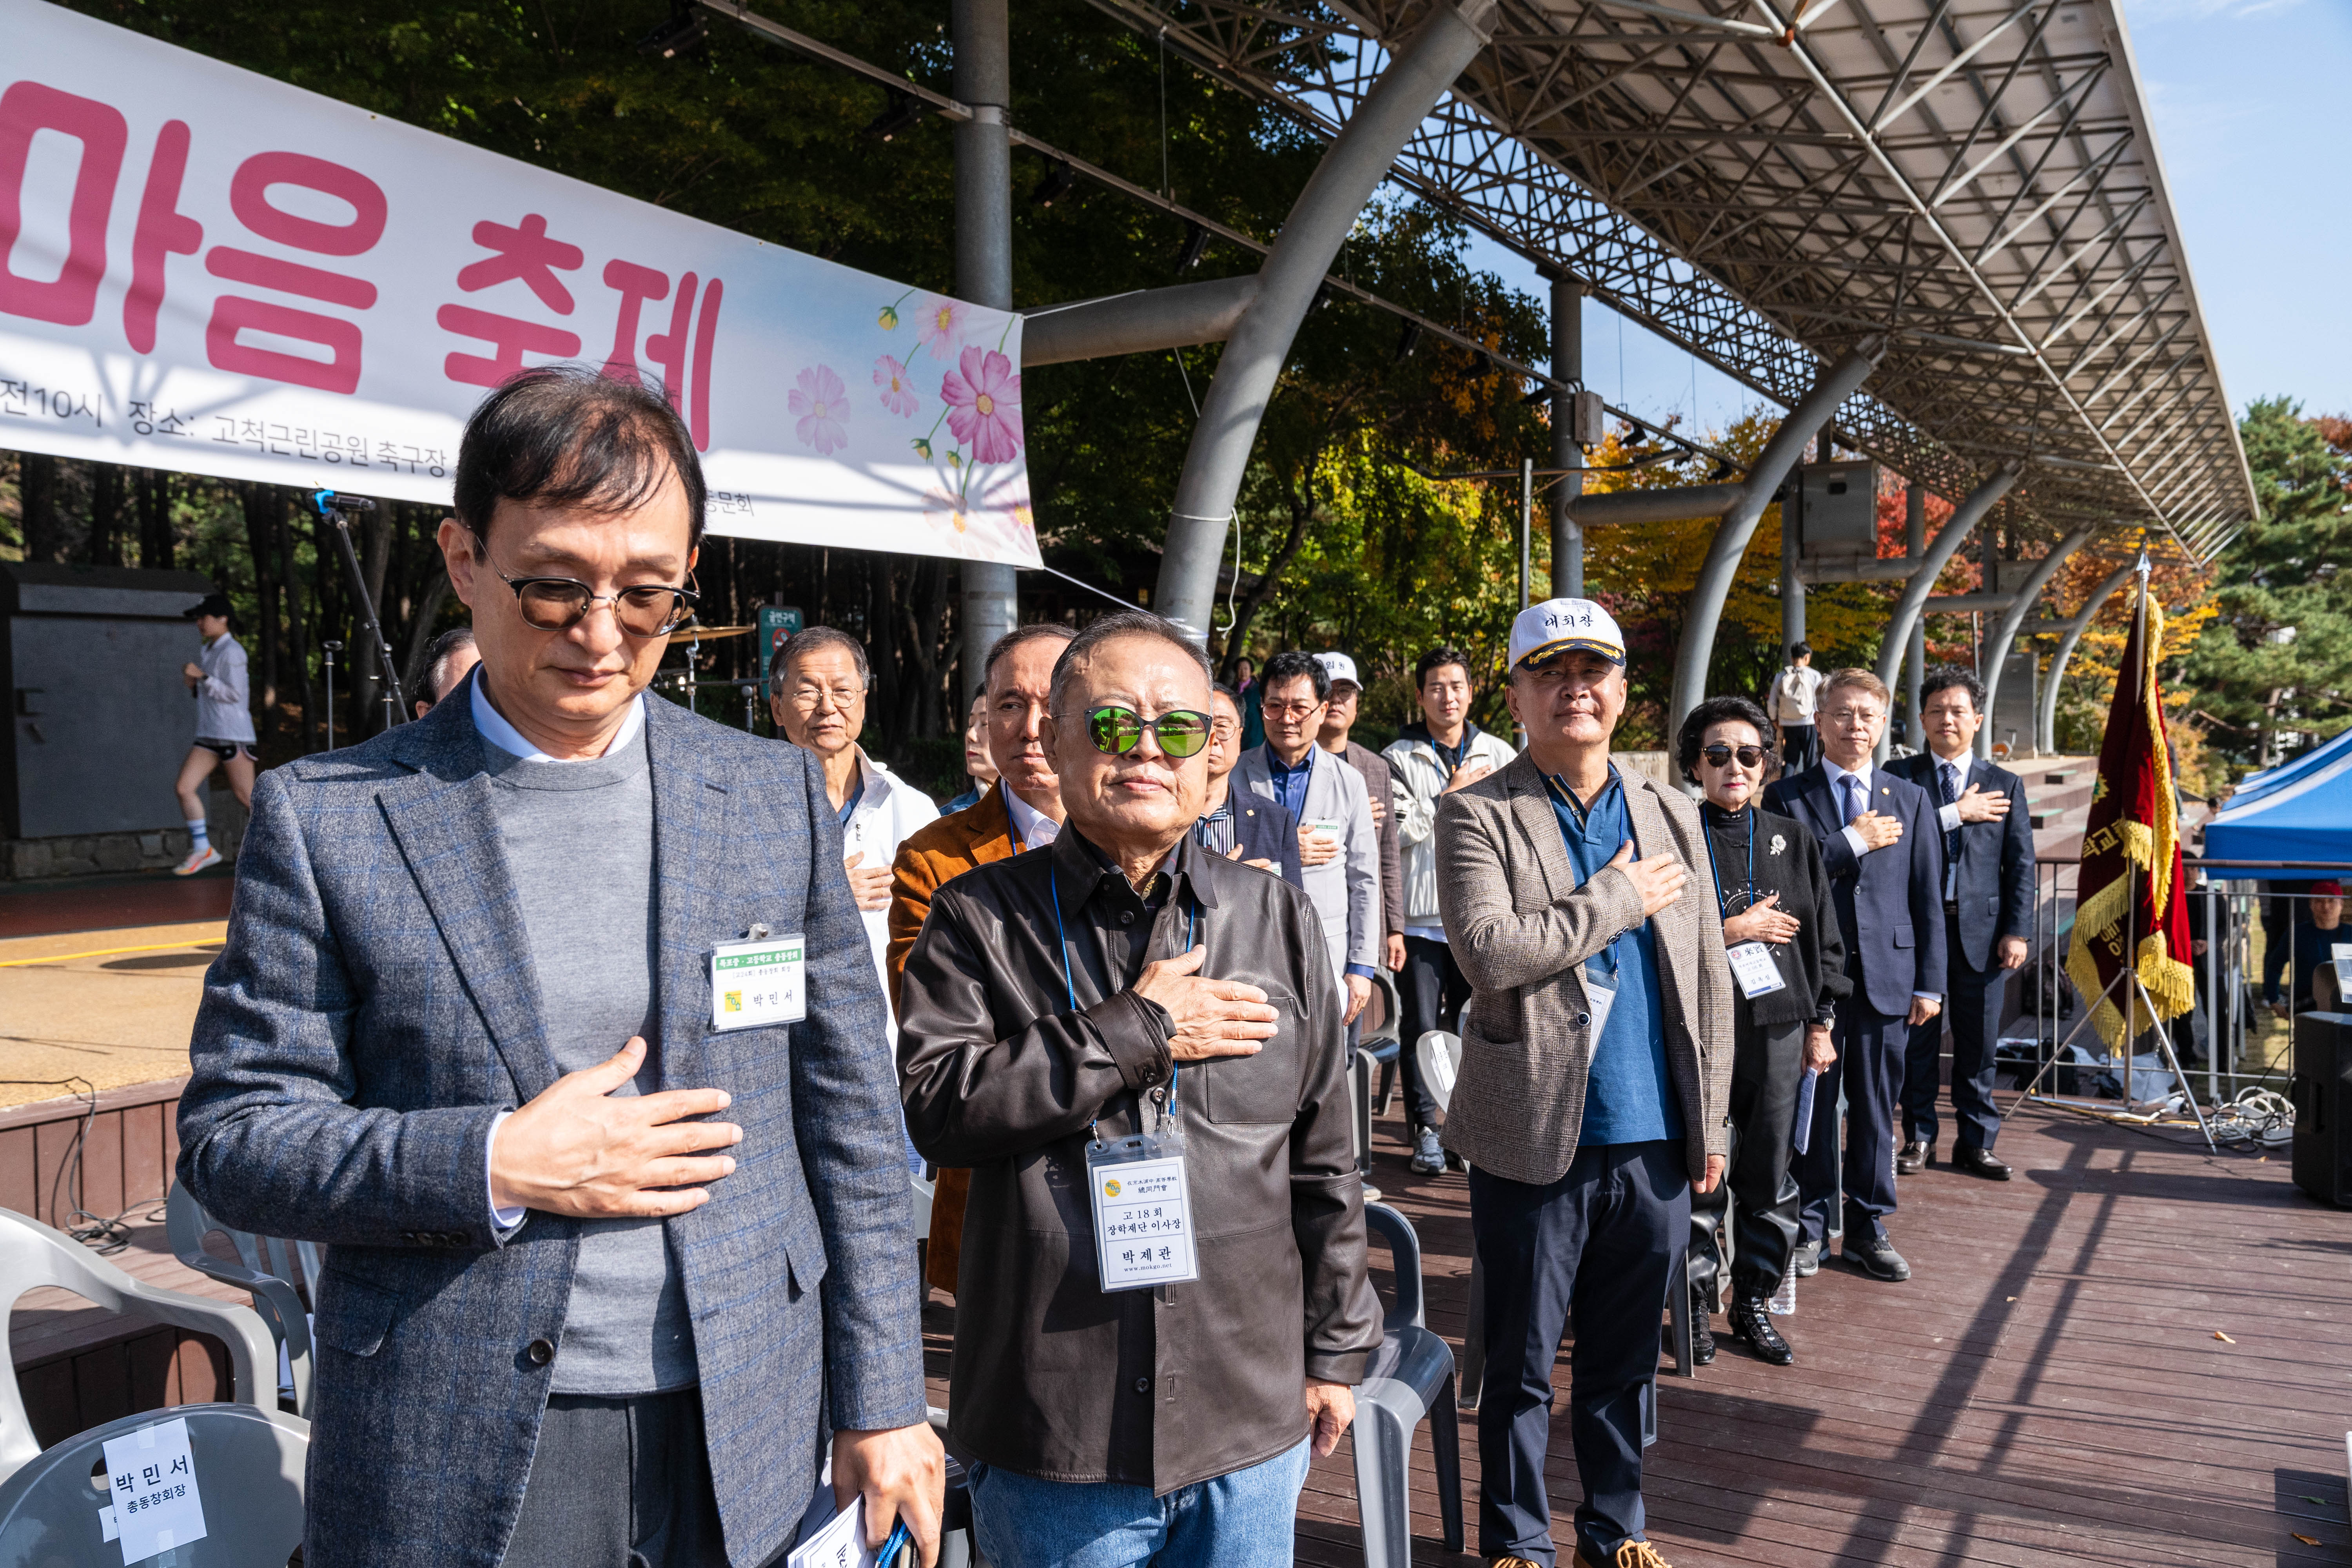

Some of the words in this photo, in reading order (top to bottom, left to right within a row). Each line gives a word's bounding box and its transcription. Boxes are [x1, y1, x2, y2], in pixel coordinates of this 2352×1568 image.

[0, 80, 387, 395] 마음
[436, 214, 723, 452] 축제
[0, 379, 102, 428] 전10시
[129, 400, 194, 436] 장소:
[212, 416, 369, 467] 고척근린공원
[377, 441, 446, 477] 축구장
[1545, 614, 1594, 629] 대회장
[746, 955, 773, 965] 고등학교
[1107, 1222, 1147, 1236] 장학재단
[1151, 1218, 1181, 1231] 이사장
[1124, 1263, 1172, 1272] www.mokgo.net
[127, 1484, 186, 1514] 총동창회장
